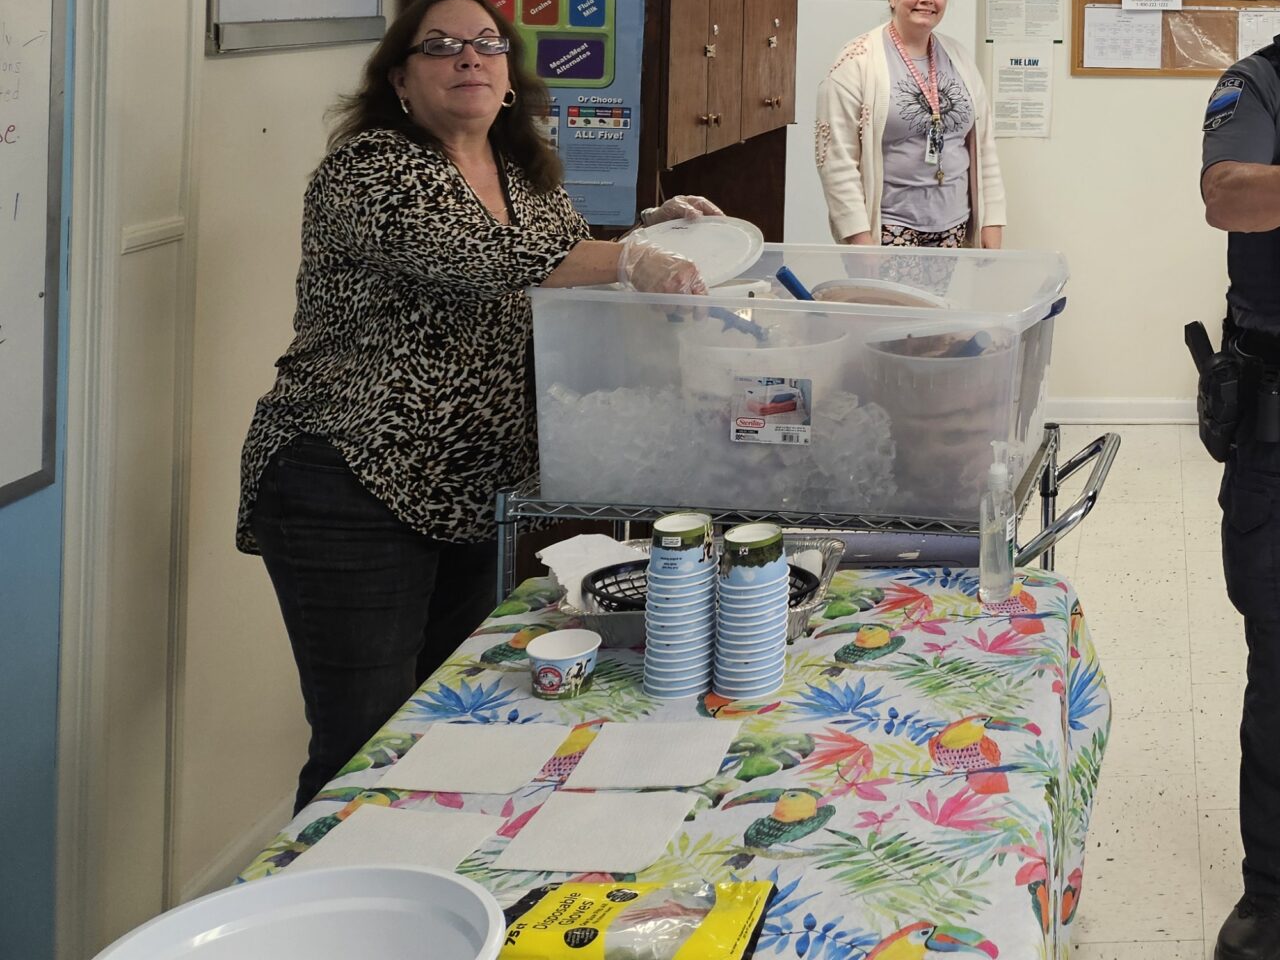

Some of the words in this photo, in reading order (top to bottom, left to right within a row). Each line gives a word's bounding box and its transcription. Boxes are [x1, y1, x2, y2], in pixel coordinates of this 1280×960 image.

[529, 0, 553, 15] Grains
[582, 6, 598, 18] Milk
[549, 42, 589, 70] Meats/Meat
[556, 50, 592, 75] Alternates
[1010, 58, 1022, 66] THE
[1024, 58, 1039, 66] LAW
[577, 95, 588, 103] Or
[590, 95, 624, 104] Choose
[574, 130, 595, 139] ALL
[598, 131, 624, 140] Five!
[532, 892, 581, 930] Disposable
[558, 900, 594, 926] Gloves
[504, 929, 521, 946] 75
